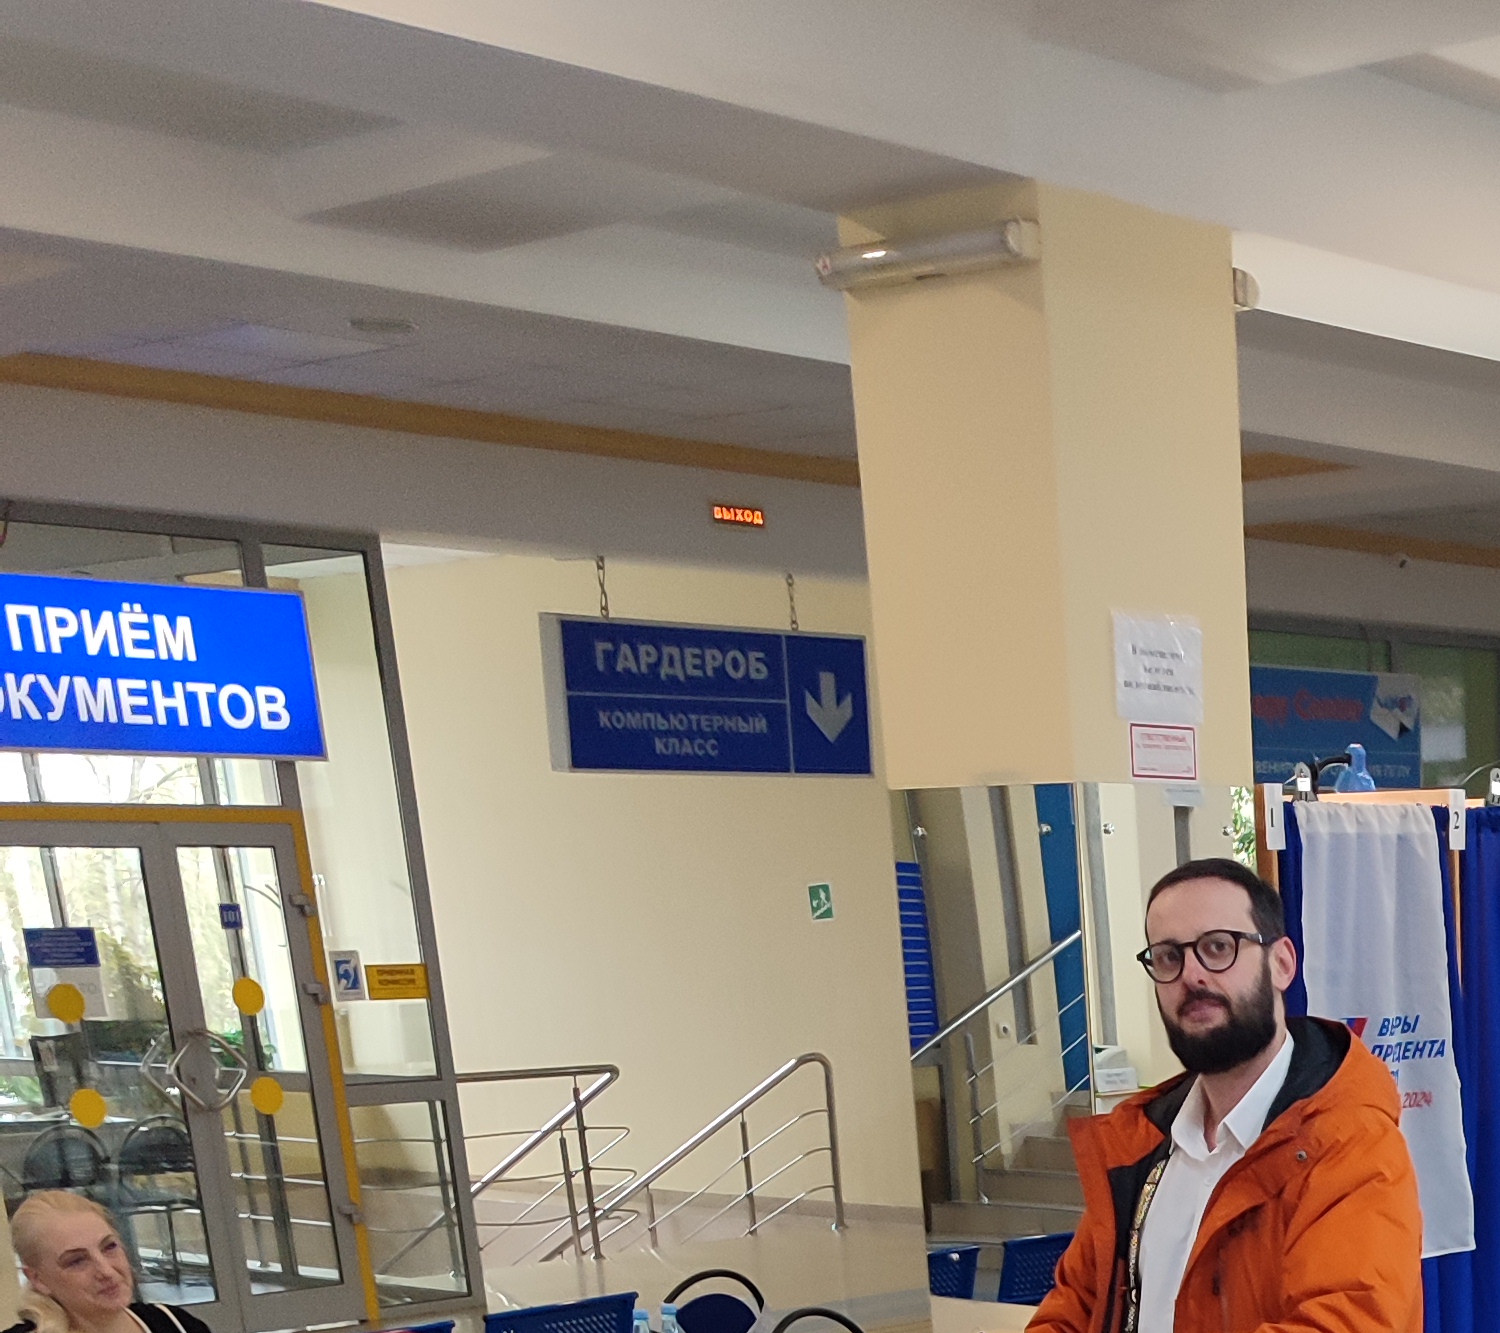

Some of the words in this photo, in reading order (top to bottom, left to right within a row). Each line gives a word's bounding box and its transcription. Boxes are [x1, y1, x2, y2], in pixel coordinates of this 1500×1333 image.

[713, 505, 764, 526] ВЫХОД
[4, 601, 198, 662] ПРИЁМ
[594, 640, 769, 682] ГАРДЕРОБ
[0, 671, 291, 731] КУМЕНТОВ
[599, 709, 768, 735] КОМПЬЮТЕРНЫЙ
[654, 737, 719, 757] КЛАСС
[1270, 807, 1275, 828] 1
[1453, 810, 1460, 830] 2
[1402, 1090, 1433, 1109] 2024
